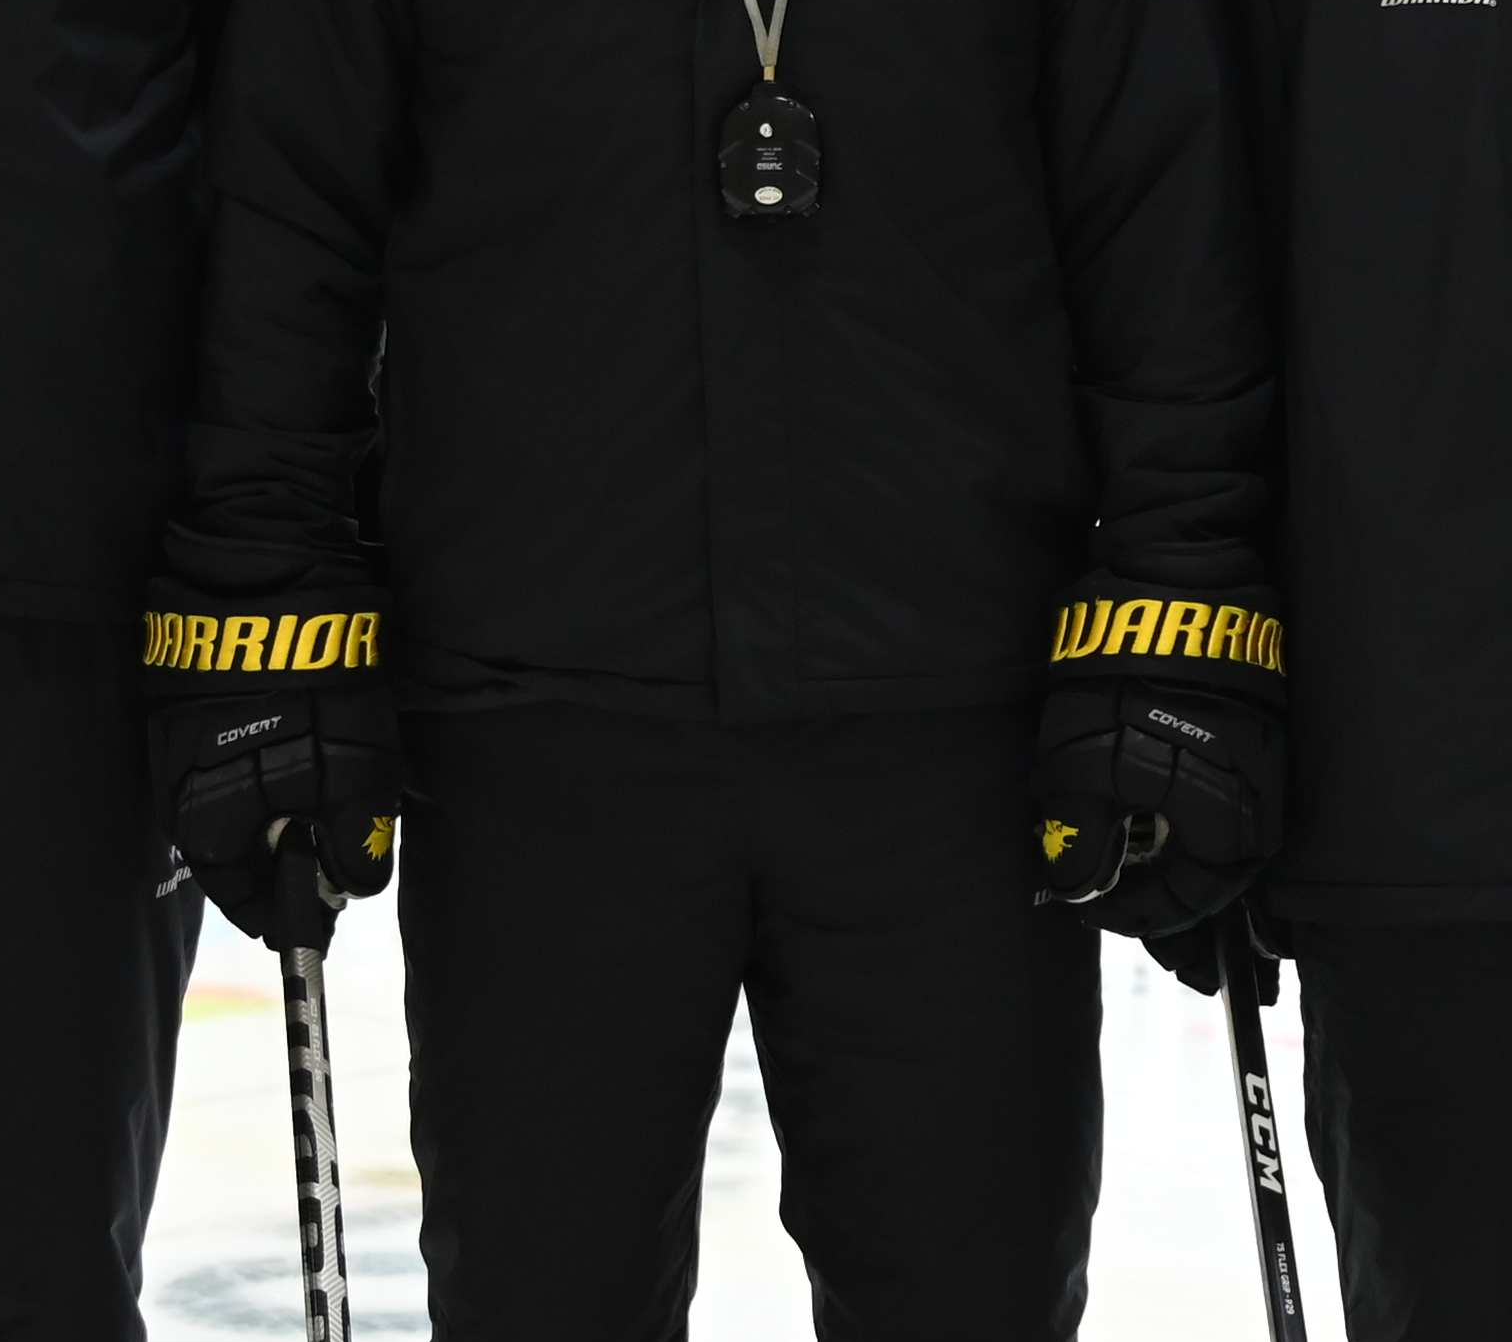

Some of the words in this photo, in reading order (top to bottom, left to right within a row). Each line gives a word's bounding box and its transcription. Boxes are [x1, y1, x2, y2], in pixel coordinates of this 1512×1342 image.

[217, 715, 283, 746] COVERT
[1148, 707, 1216, 744] COVERT
[1244, 1070, 1283, 1196] CCM
[1277, 1252, 1288, 1273] FLEX
[1280, 1273, 1291, 1293] GRIP
[1283, 1297, 1295, 1315] P29
